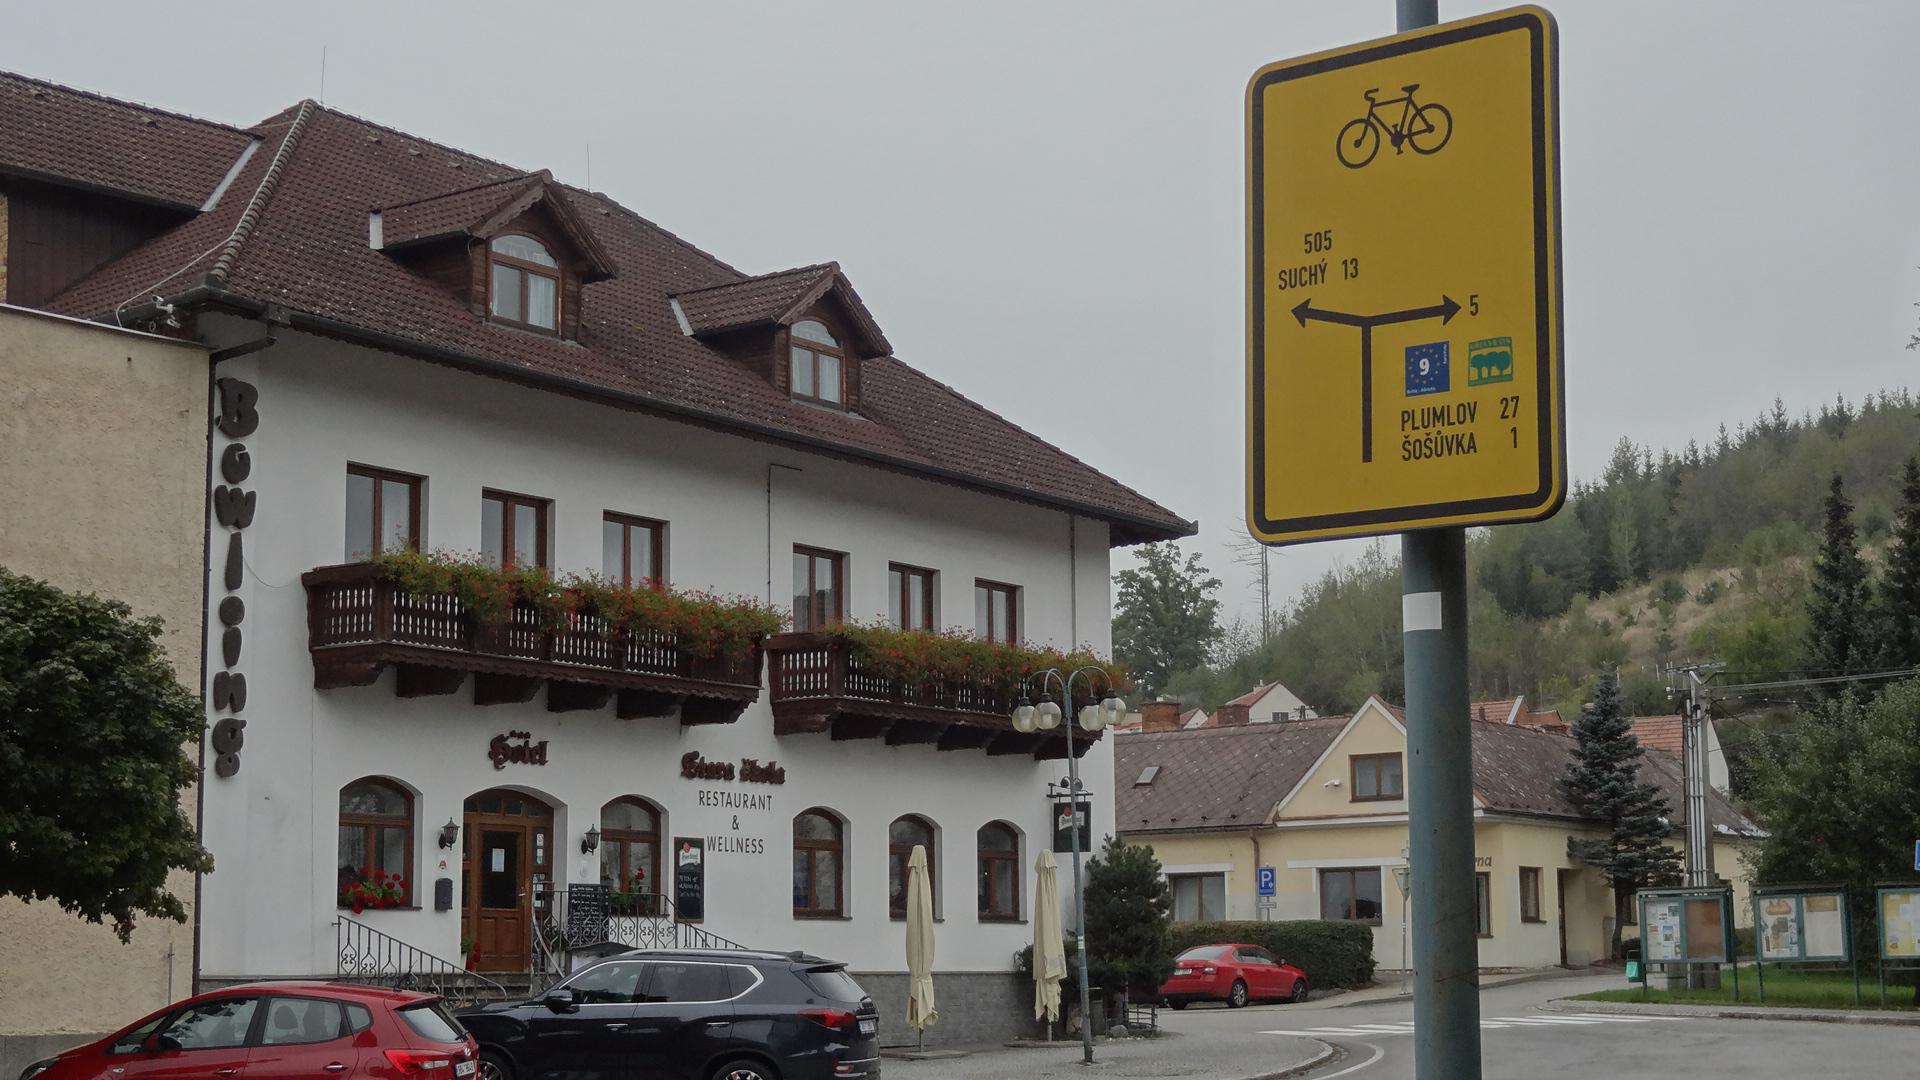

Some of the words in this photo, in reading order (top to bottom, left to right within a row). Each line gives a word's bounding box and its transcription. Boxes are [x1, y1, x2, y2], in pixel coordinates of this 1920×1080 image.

[1304, 229, 1333, 254] 505
[1278, 257, 1328, 291] SUCHÝ
[1342, 257, 1359, 281] 13
[1469, 294, 1479, 317] 5
[1419, 358, 1430, 376] 9
[1401, 401, 1478, 432] PLUMLOV
[1499, 395, 1520, 420] 27
[1401, 430, 1478, 462] ŠOŠŮVKA
[1510, 426, 1518, 449] 1
[488, 733, 550, 770] Hotel
[698, 790, 772, 812] RESTAURANT
[731, 814, 740, 831] &
[706, 834, 764, 855] WELLNESS
[1261, 870, 1272, 888] P
